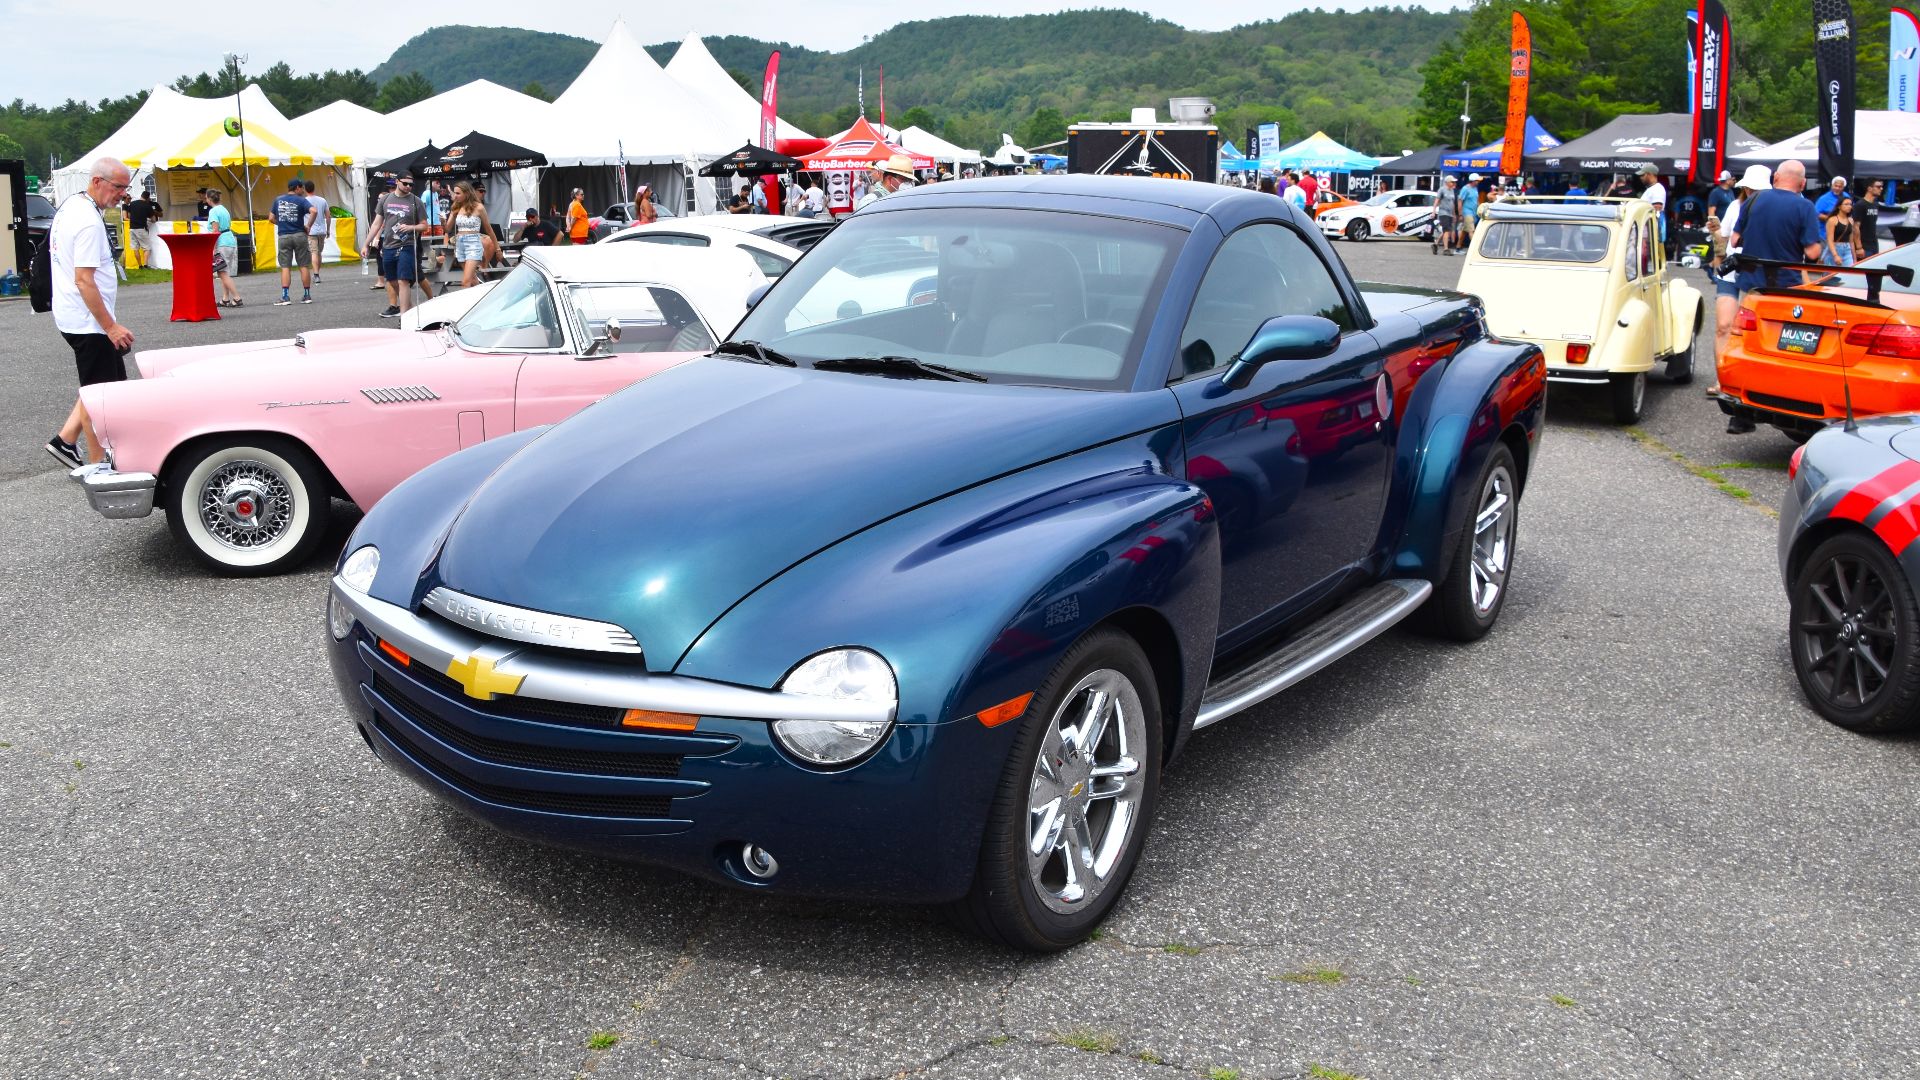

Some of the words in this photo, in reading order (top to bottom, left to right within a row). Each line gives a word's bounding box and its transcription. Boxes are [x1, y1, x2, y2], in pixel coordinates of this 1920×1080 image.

[1831, 95, 1839, 135] LEXUS
[1621, 137, 1673, 147] ACURA
[423, 165, 442, 174] Tito's
[491, 160, 508, 168] Tito's
[1355, 176, 1370, 189] FCP
[1683, 202, 1694, 211] 10
[1781, 328, 1819, 342] MUNICH
[445, 598, 584, 640] CHEVROLET
